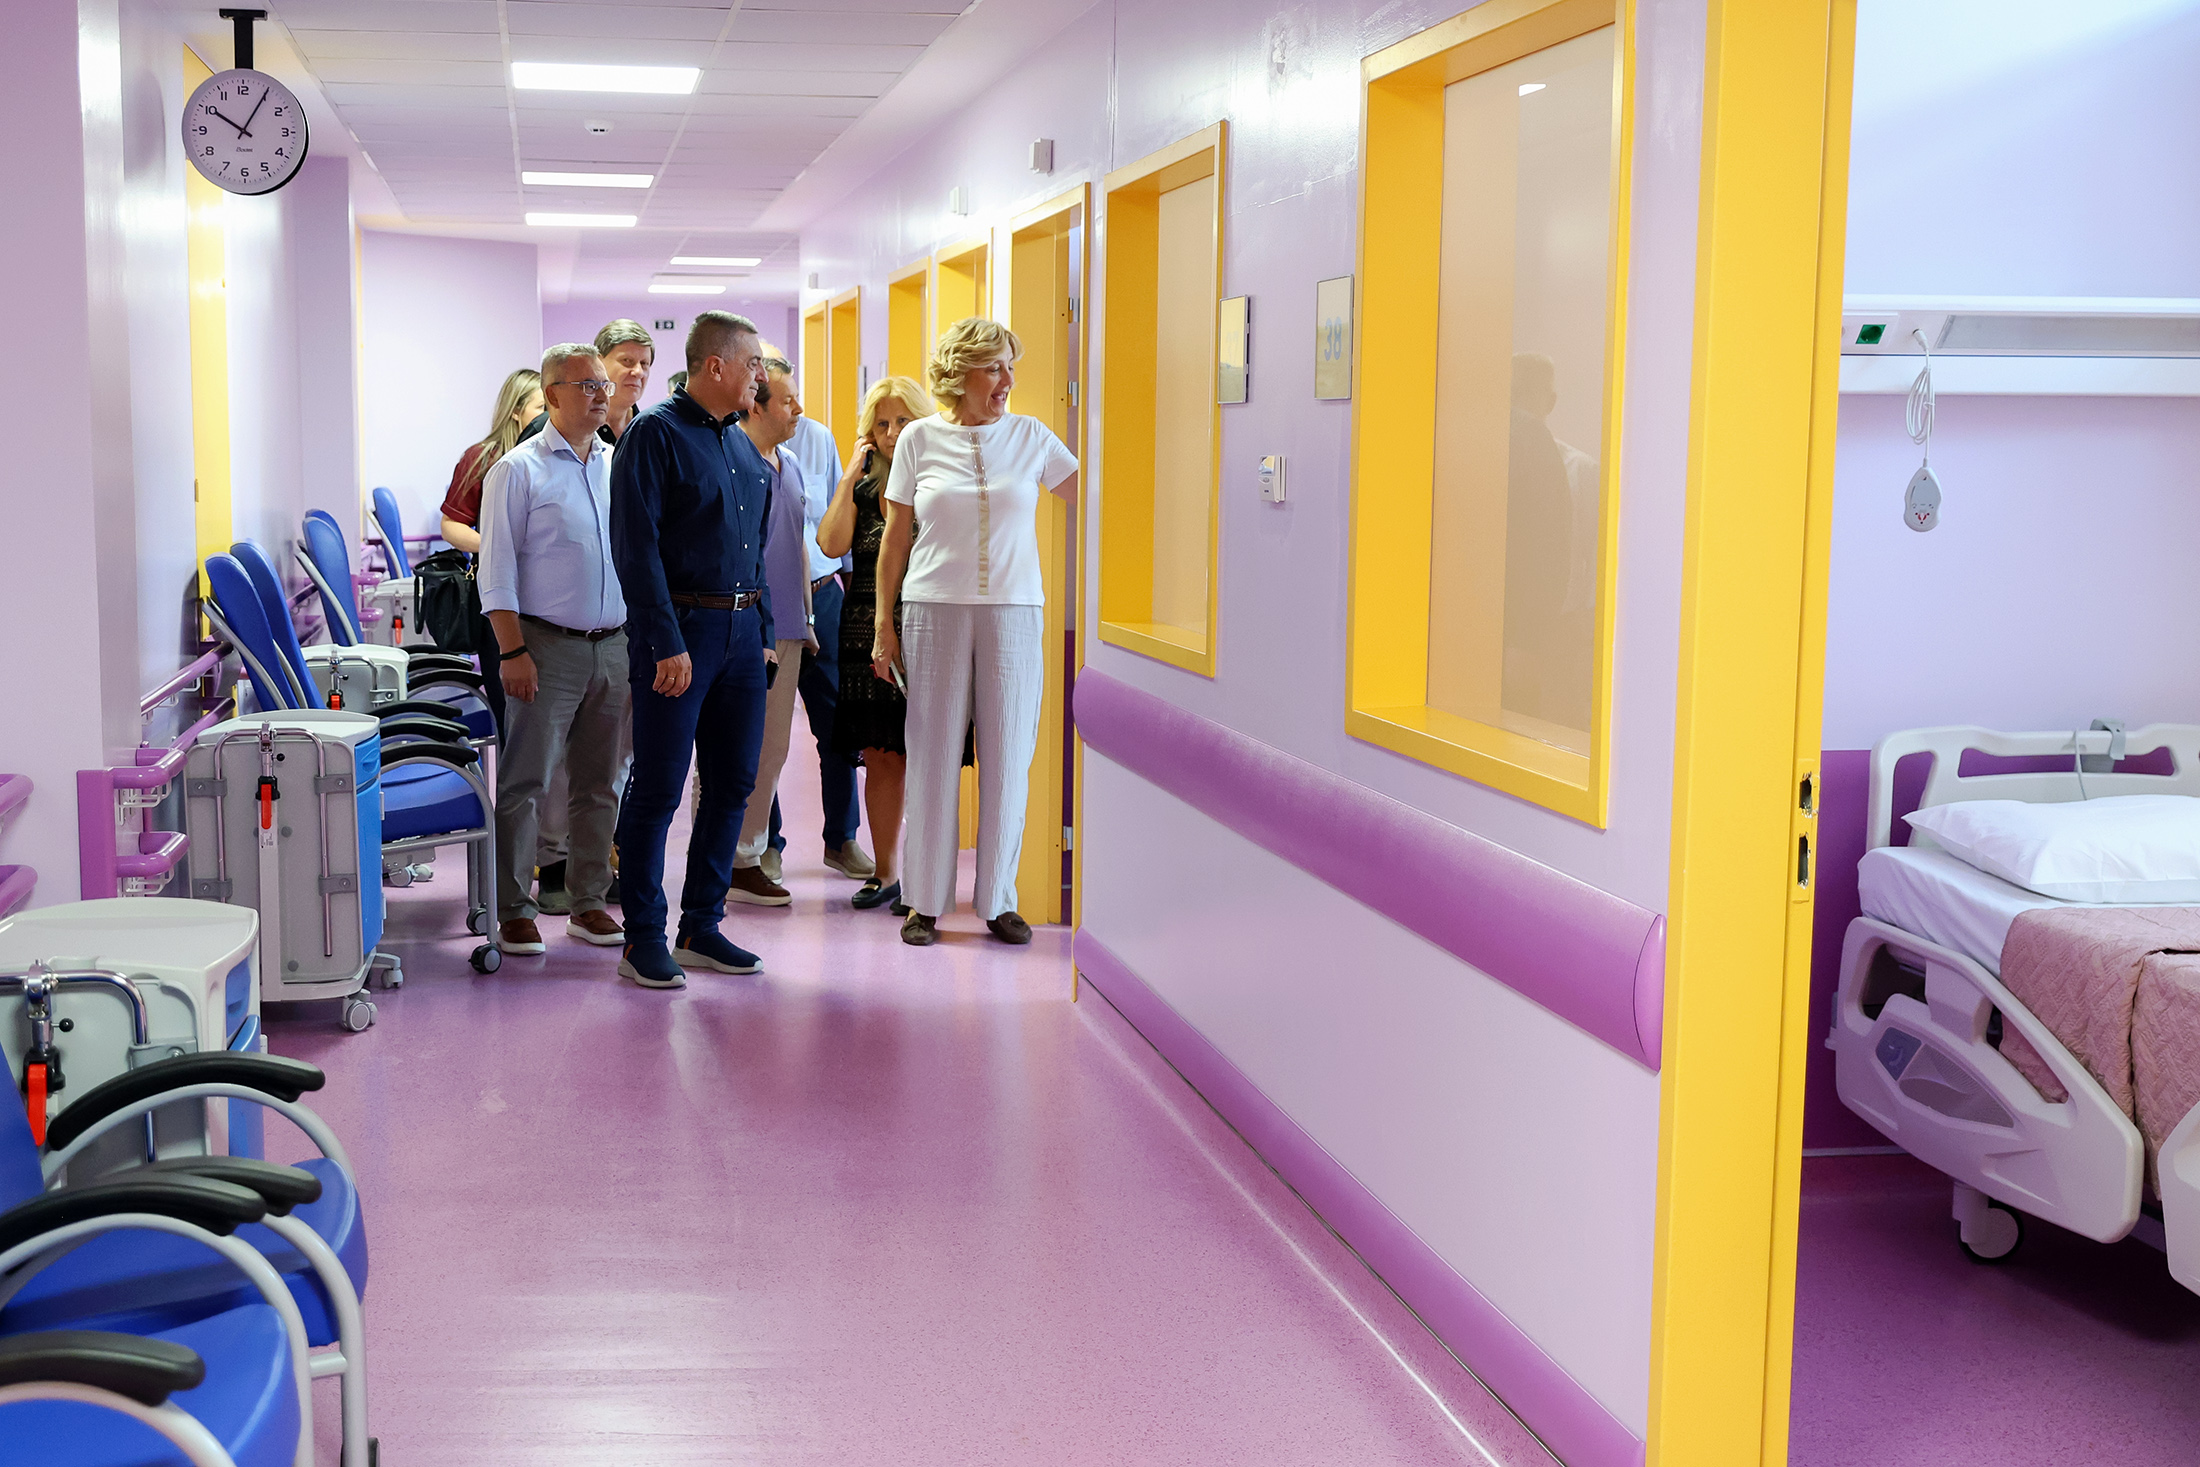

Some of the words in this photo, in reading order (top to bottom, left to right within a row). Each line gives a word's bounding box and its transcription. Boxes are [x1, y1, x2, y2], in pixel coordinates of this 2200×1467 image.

[237, 85, 249, 95] 12
[220, 91, 228, 101] 11
[205, 105, 217, 115] 10
[274, 106, 283, 117] 2
[198, 126, 208, 135] 9
[281, 127, 290, 137] 3
[205, 146, 214, 156] 8
[274, 147, 284, 157] 4
[222, 161, 231, 171] 7
[260, 162, 269, 172] 5
[240, 167, 249, 177] 6
[1324, 316, 1342, 361] 38
